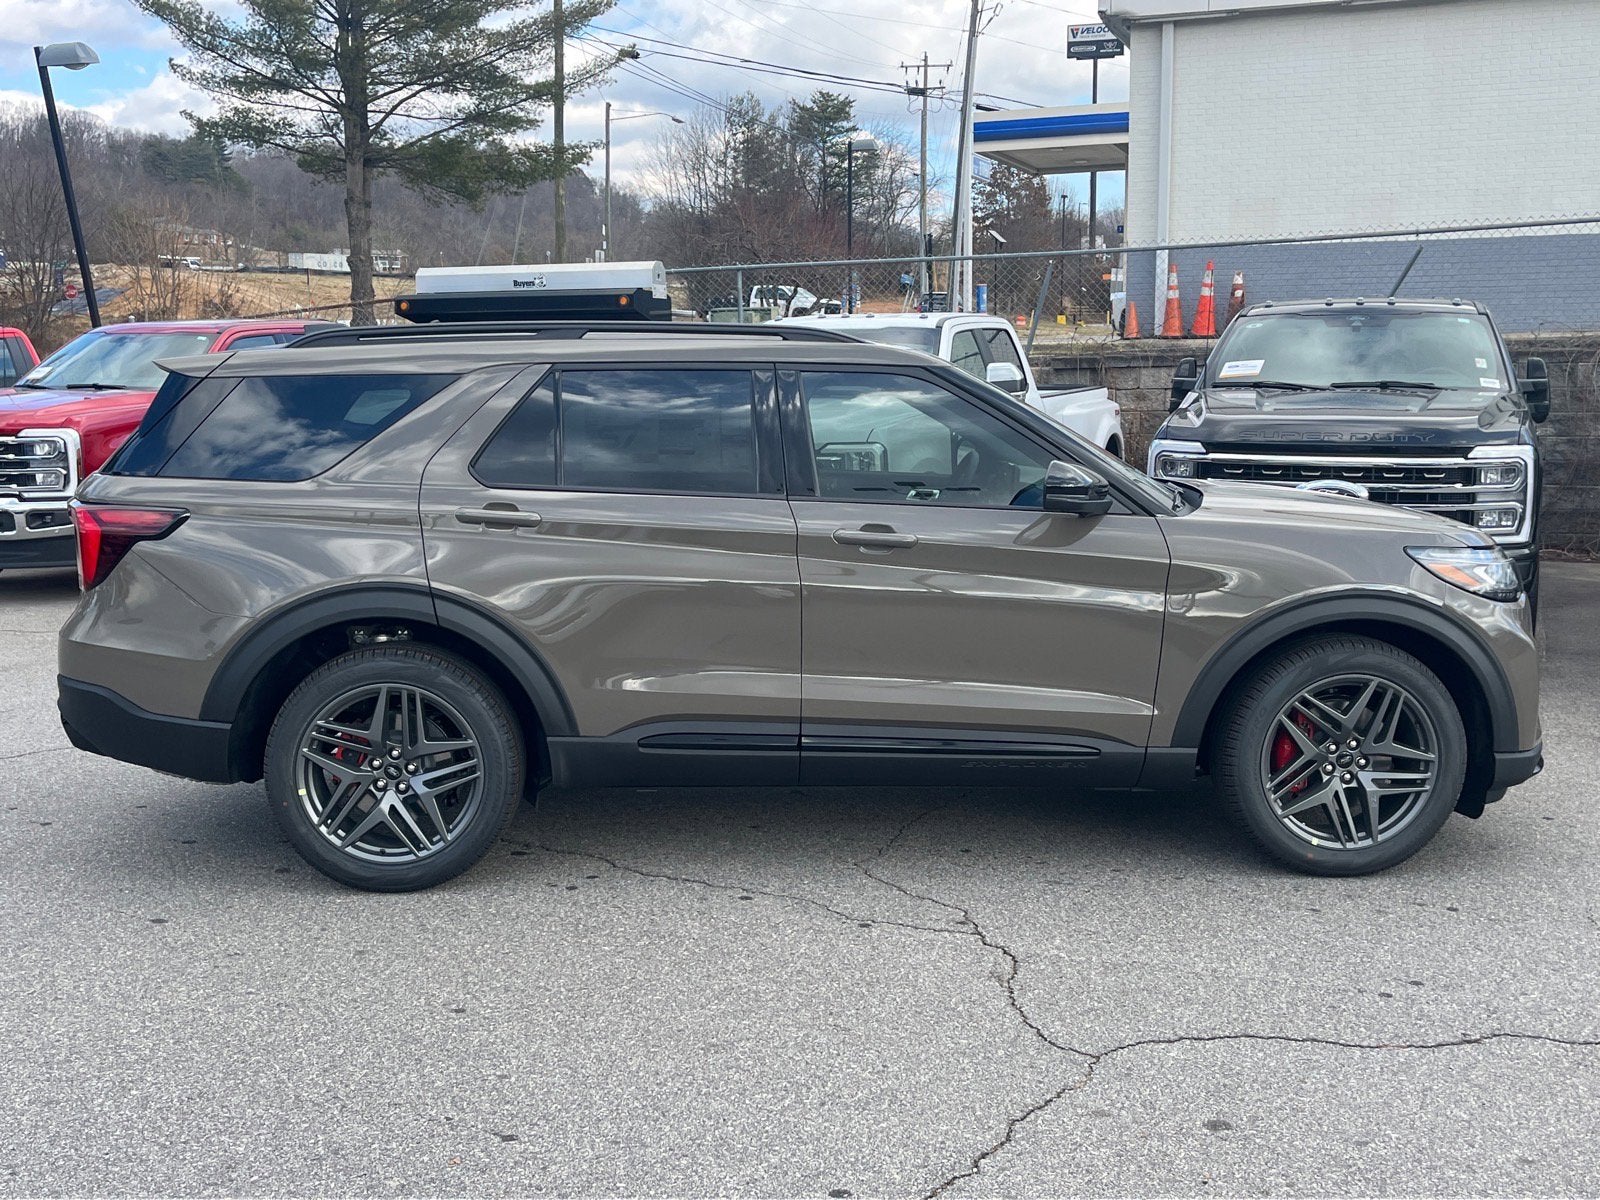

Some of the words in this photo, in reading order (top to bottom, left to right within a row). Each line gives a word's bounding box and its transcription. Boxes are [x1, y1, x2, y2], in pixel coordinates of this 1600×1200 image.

[512, 279, 536, 289] Buyers
[1238, 430, 1344, 442] SUPER
[1349, 431, 1436, 442] DUTY
